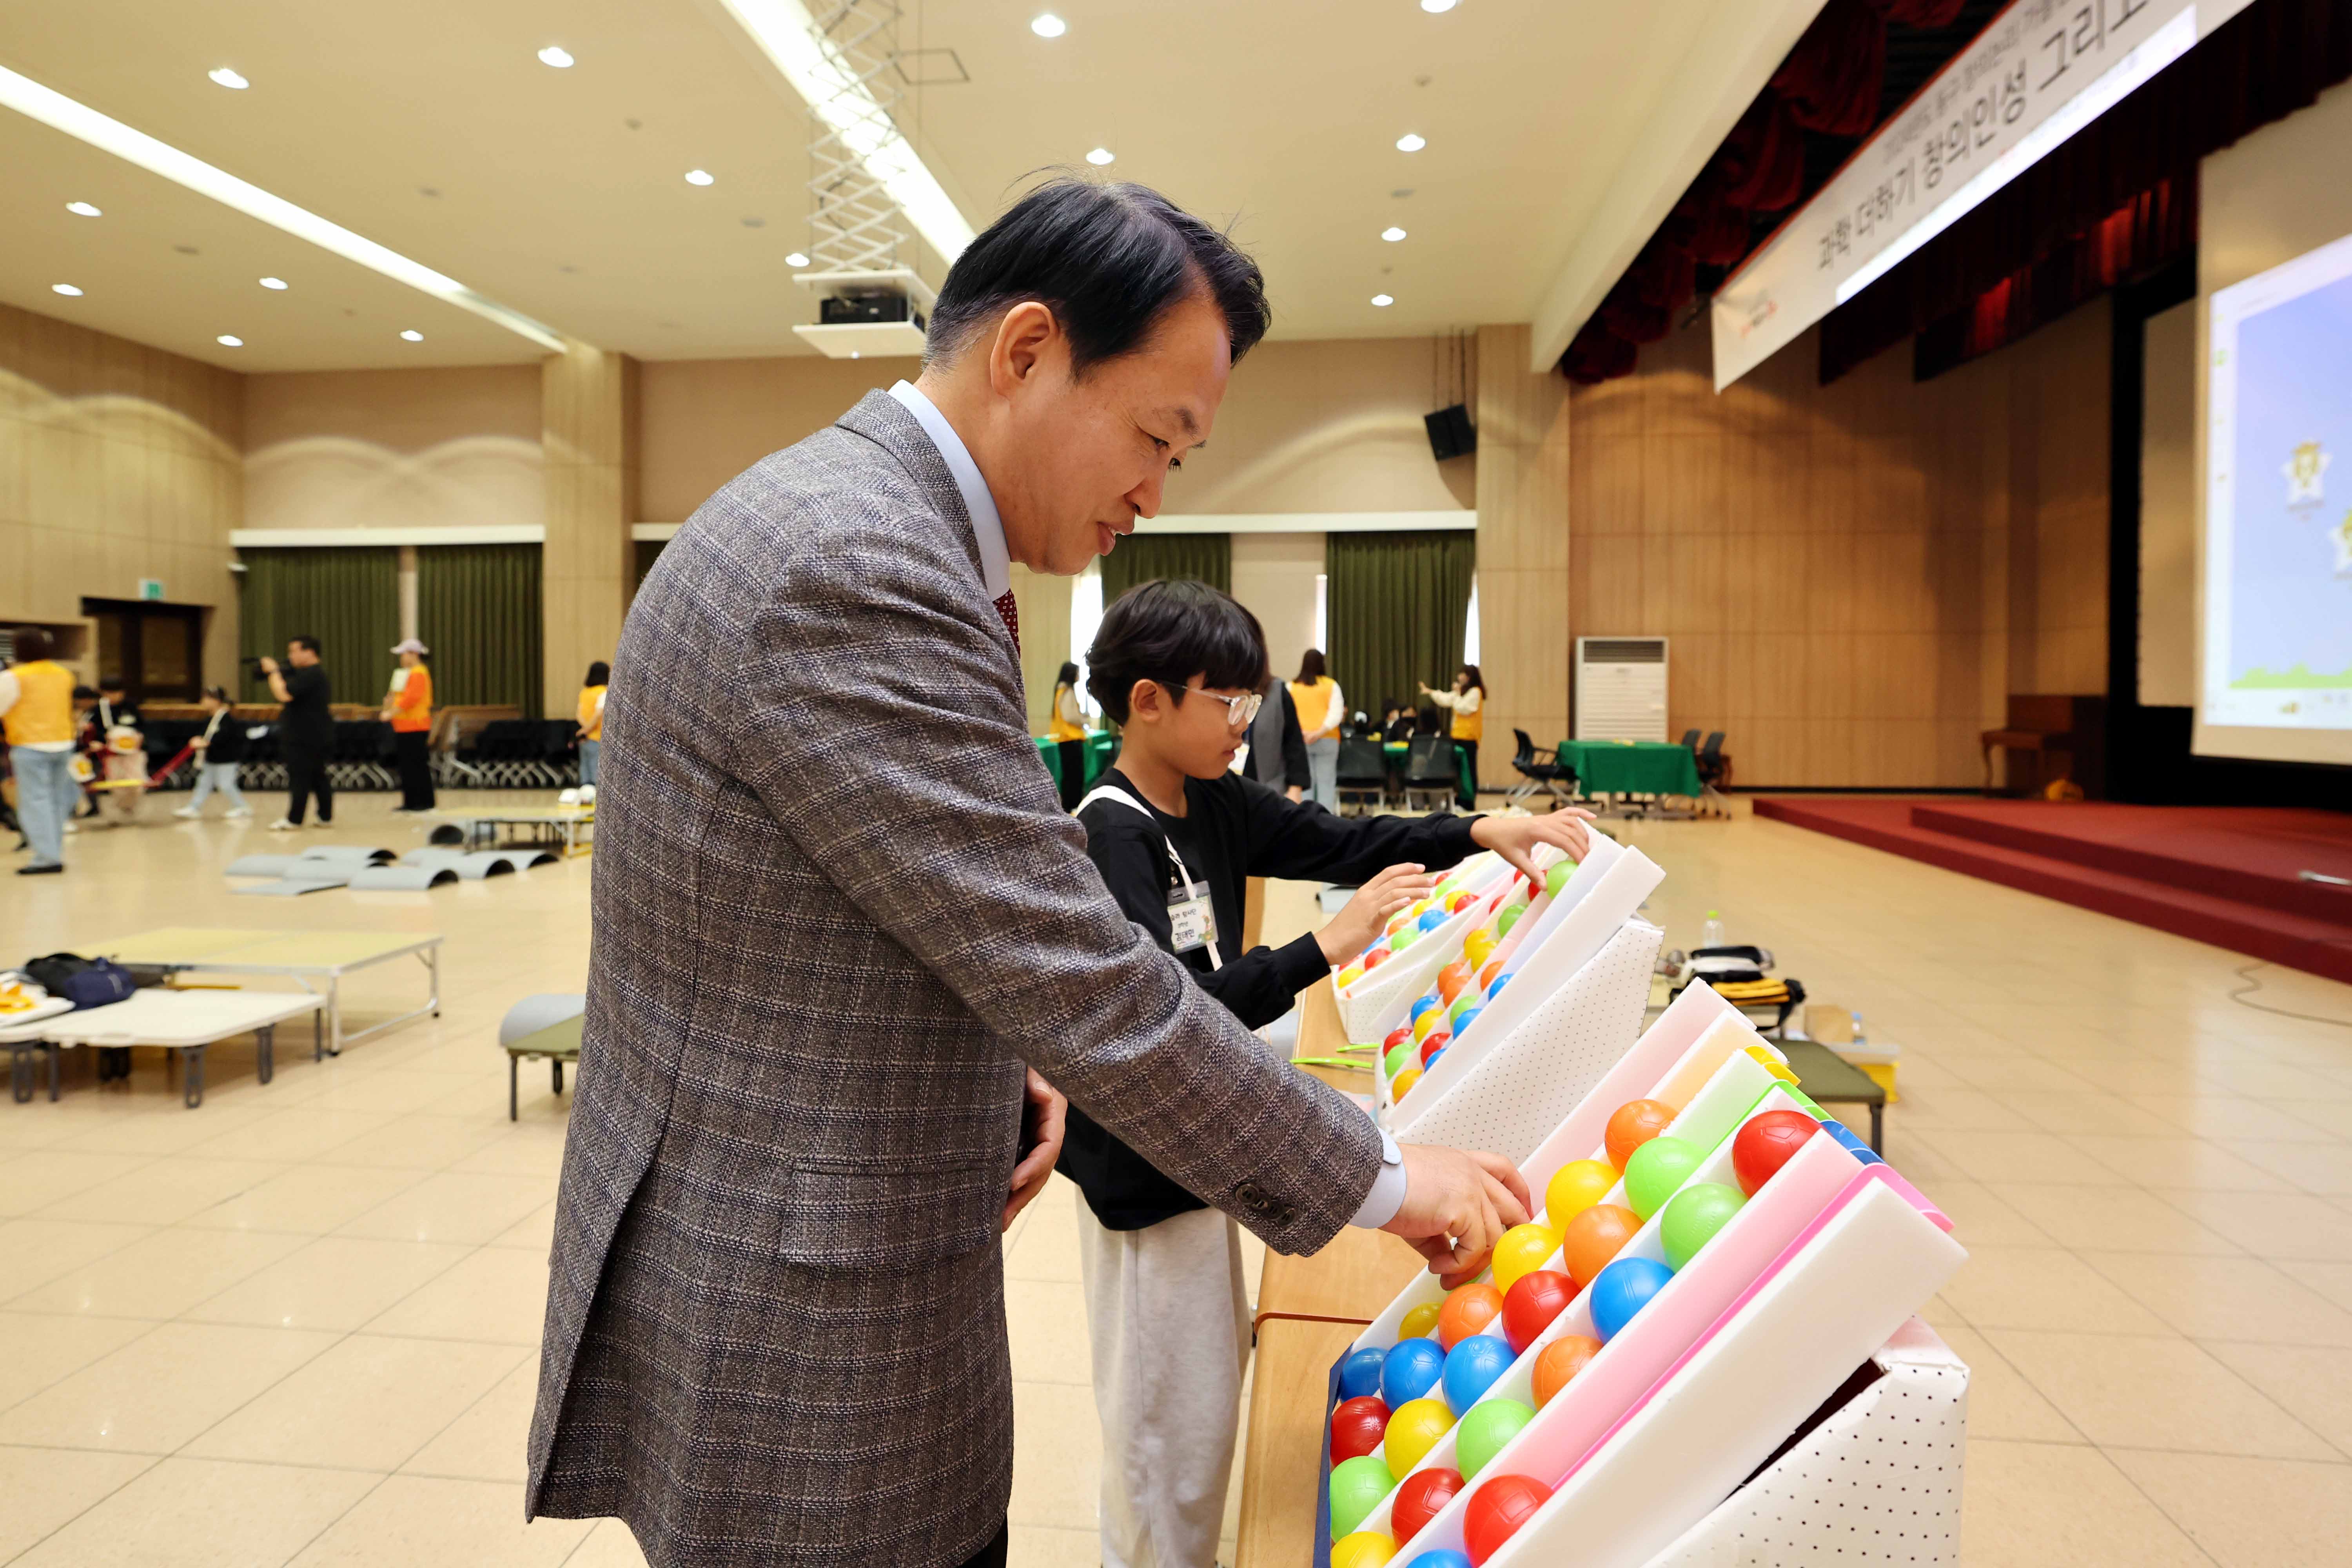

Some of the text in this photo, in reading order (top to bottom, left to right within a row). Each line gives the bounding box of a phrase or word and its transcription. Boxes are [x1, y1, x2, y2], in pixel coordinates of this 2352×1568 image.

[1818, 216, 1851, 270] 과학
[1856, 156, 1916, 236] 더하기
[1922, 57, 2026, 190] 창의인성
